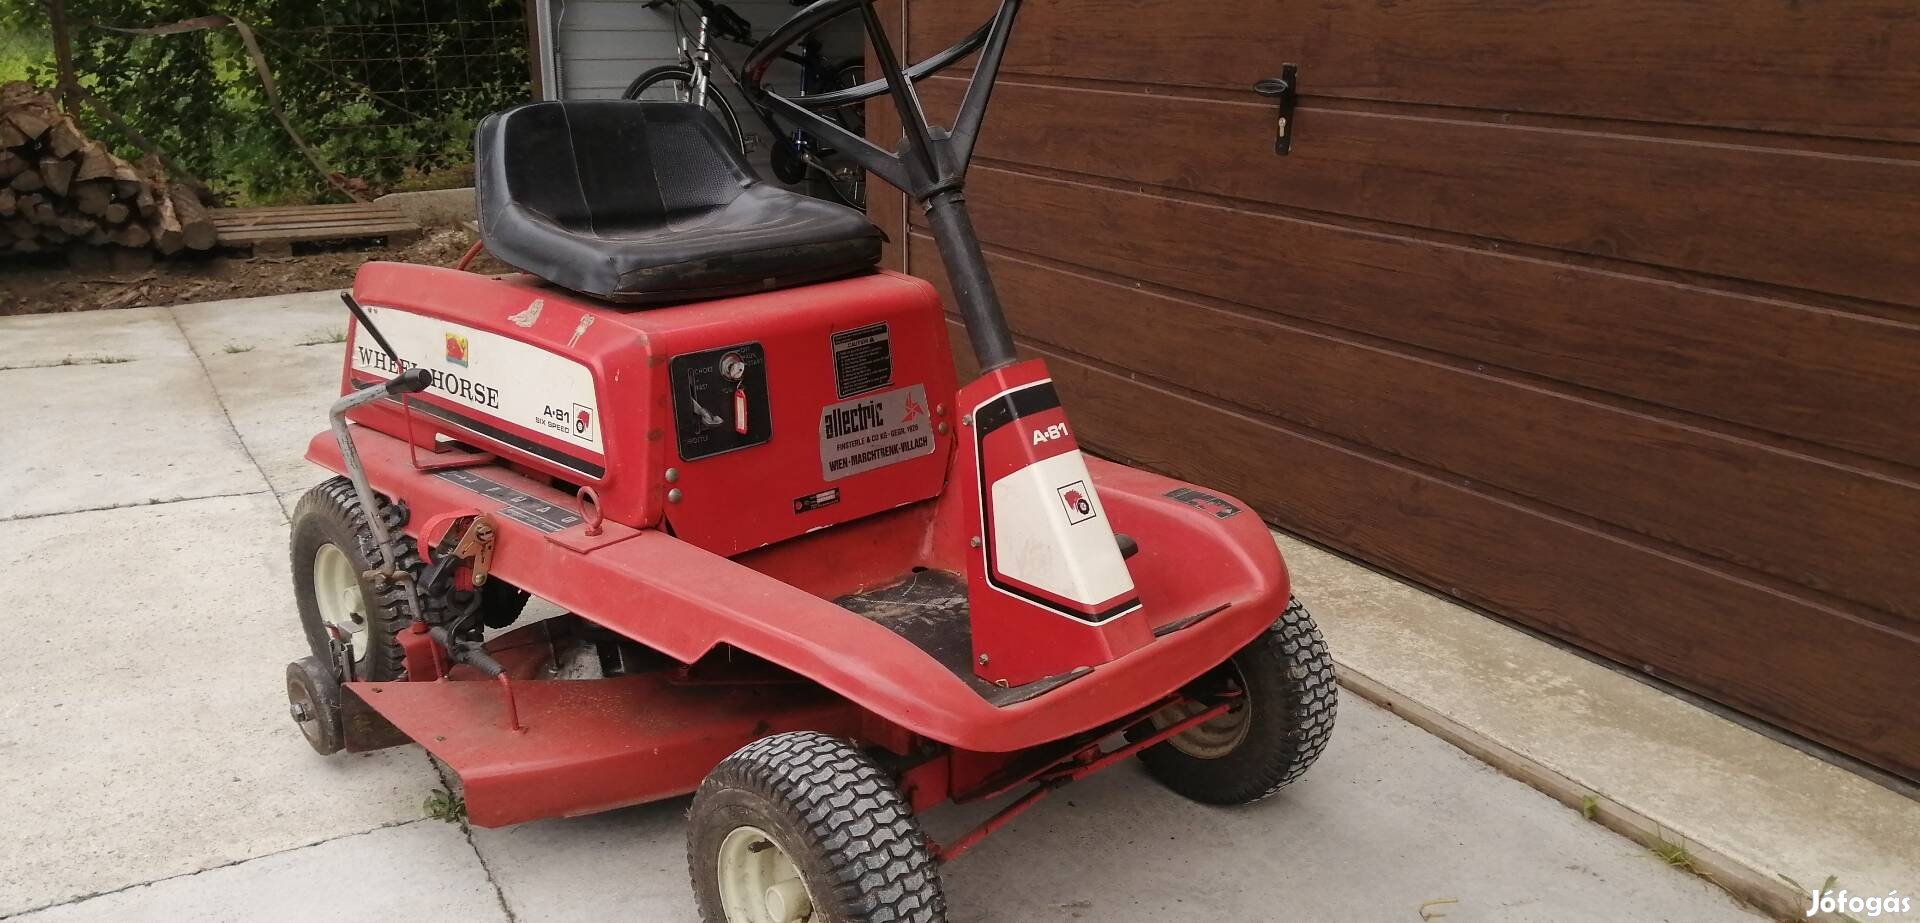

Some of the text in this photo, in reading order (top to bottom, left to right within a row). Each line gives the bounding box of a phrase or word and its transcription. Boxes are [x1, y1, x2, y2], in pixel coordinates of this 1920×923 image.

[359, 346, 499, 410] WHEE HORSE
[535, 416, 570, 434] SIX SPEED
[824, 400, 884, 439] allectric
